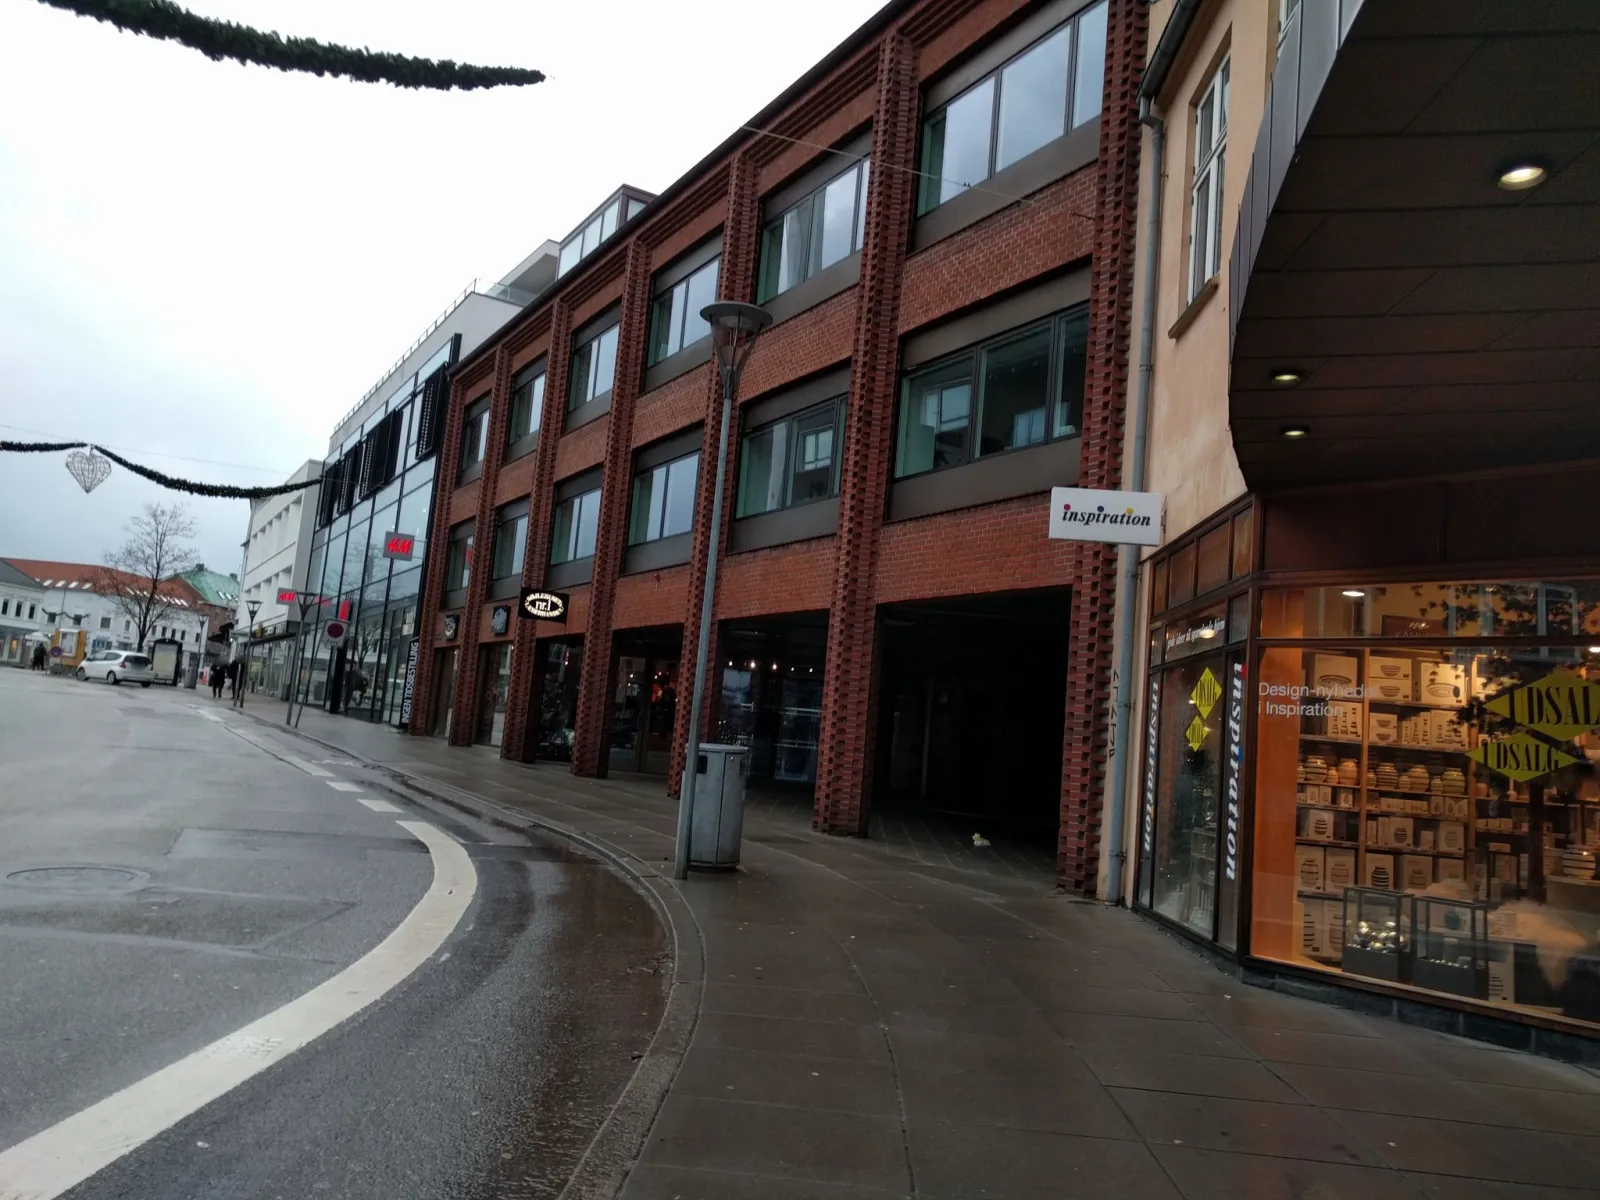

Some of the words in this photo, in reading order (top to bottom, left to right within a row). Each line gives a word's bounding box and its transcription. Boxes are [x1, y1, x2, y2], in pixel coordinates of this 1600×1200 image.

[1062, 503, 1151, 527] inspiration
[1266, 701, 1344, 718] Inspiration
[1226, 661, 1247, 881] inspiration
